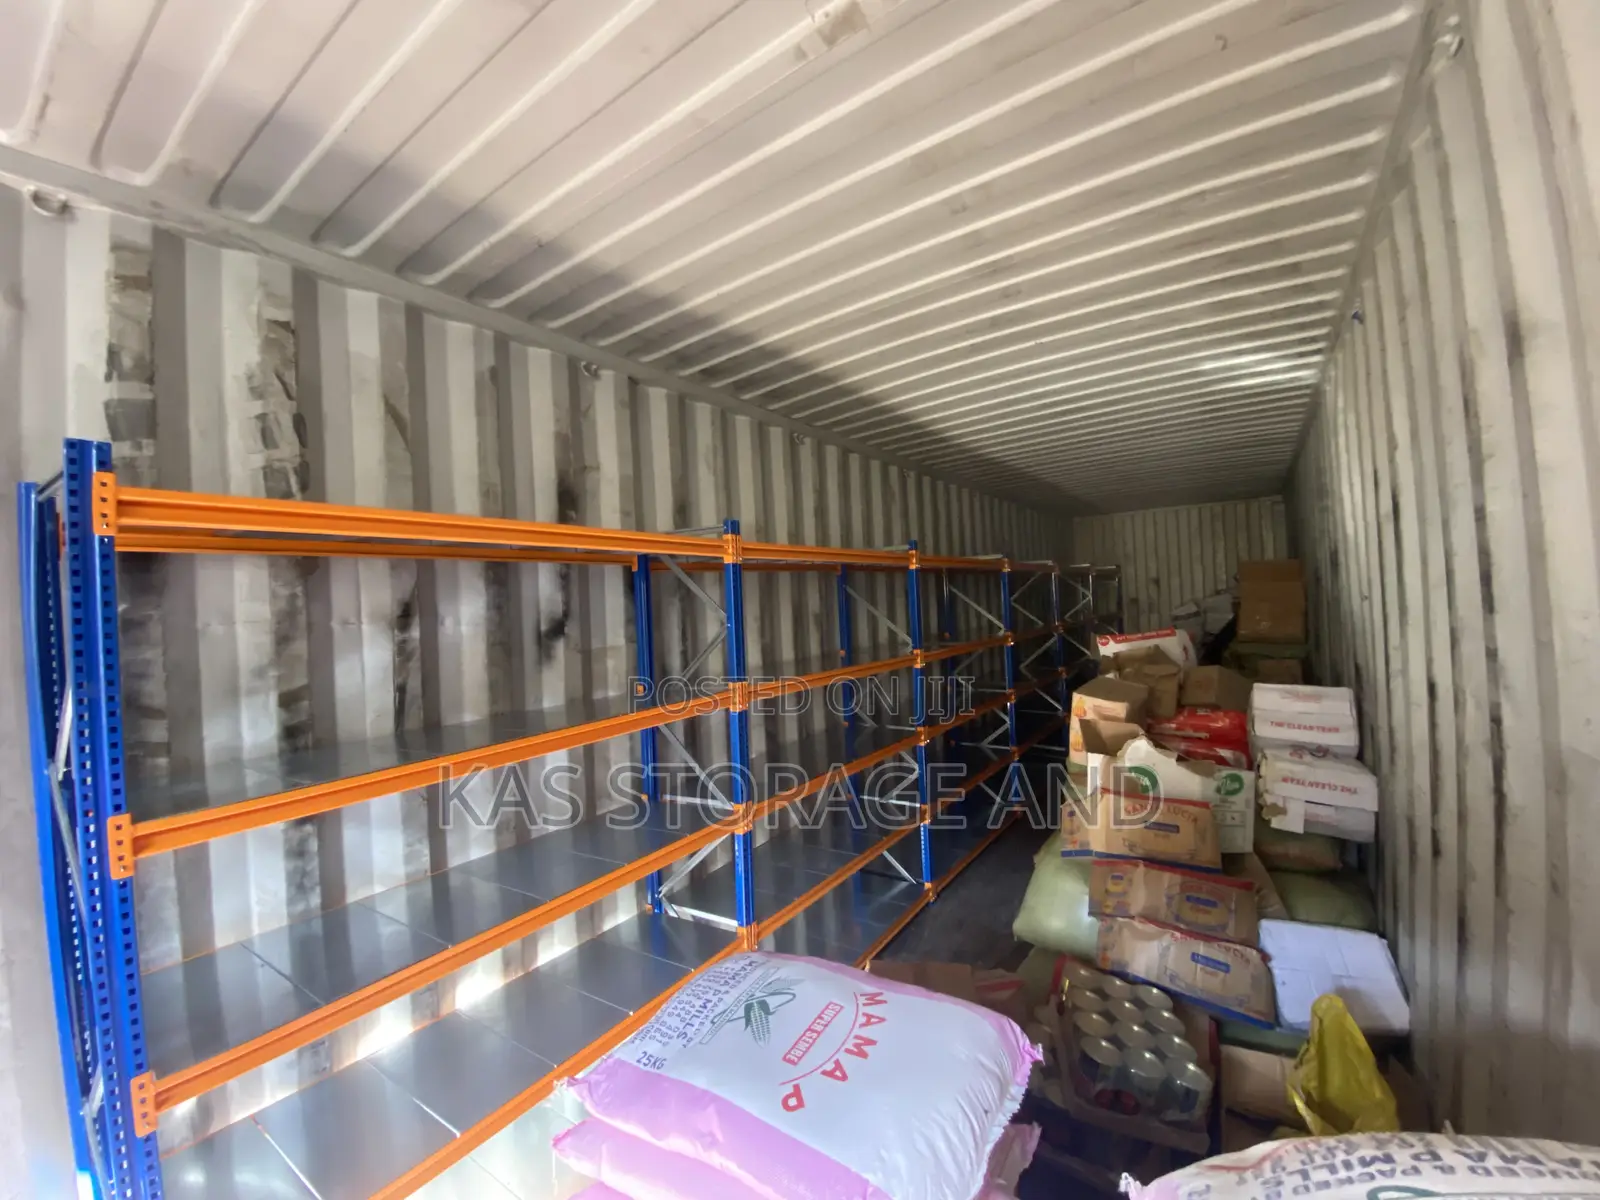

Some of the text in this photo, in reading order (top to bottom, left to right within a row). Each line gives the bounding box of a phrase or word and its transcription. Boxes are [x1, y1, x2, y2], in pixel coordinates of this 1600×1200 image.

[676, 998, 713, 1040] MILLS
[785, 1002, 841, 1064] SUPER SEMBE
[820, 991, 889, 1083] MAMA
[635, 1050, 668, 1071] 25KG
[780, 1083, 806, 1113] P
[1260, 1150, 1396, 1188] MILLS
